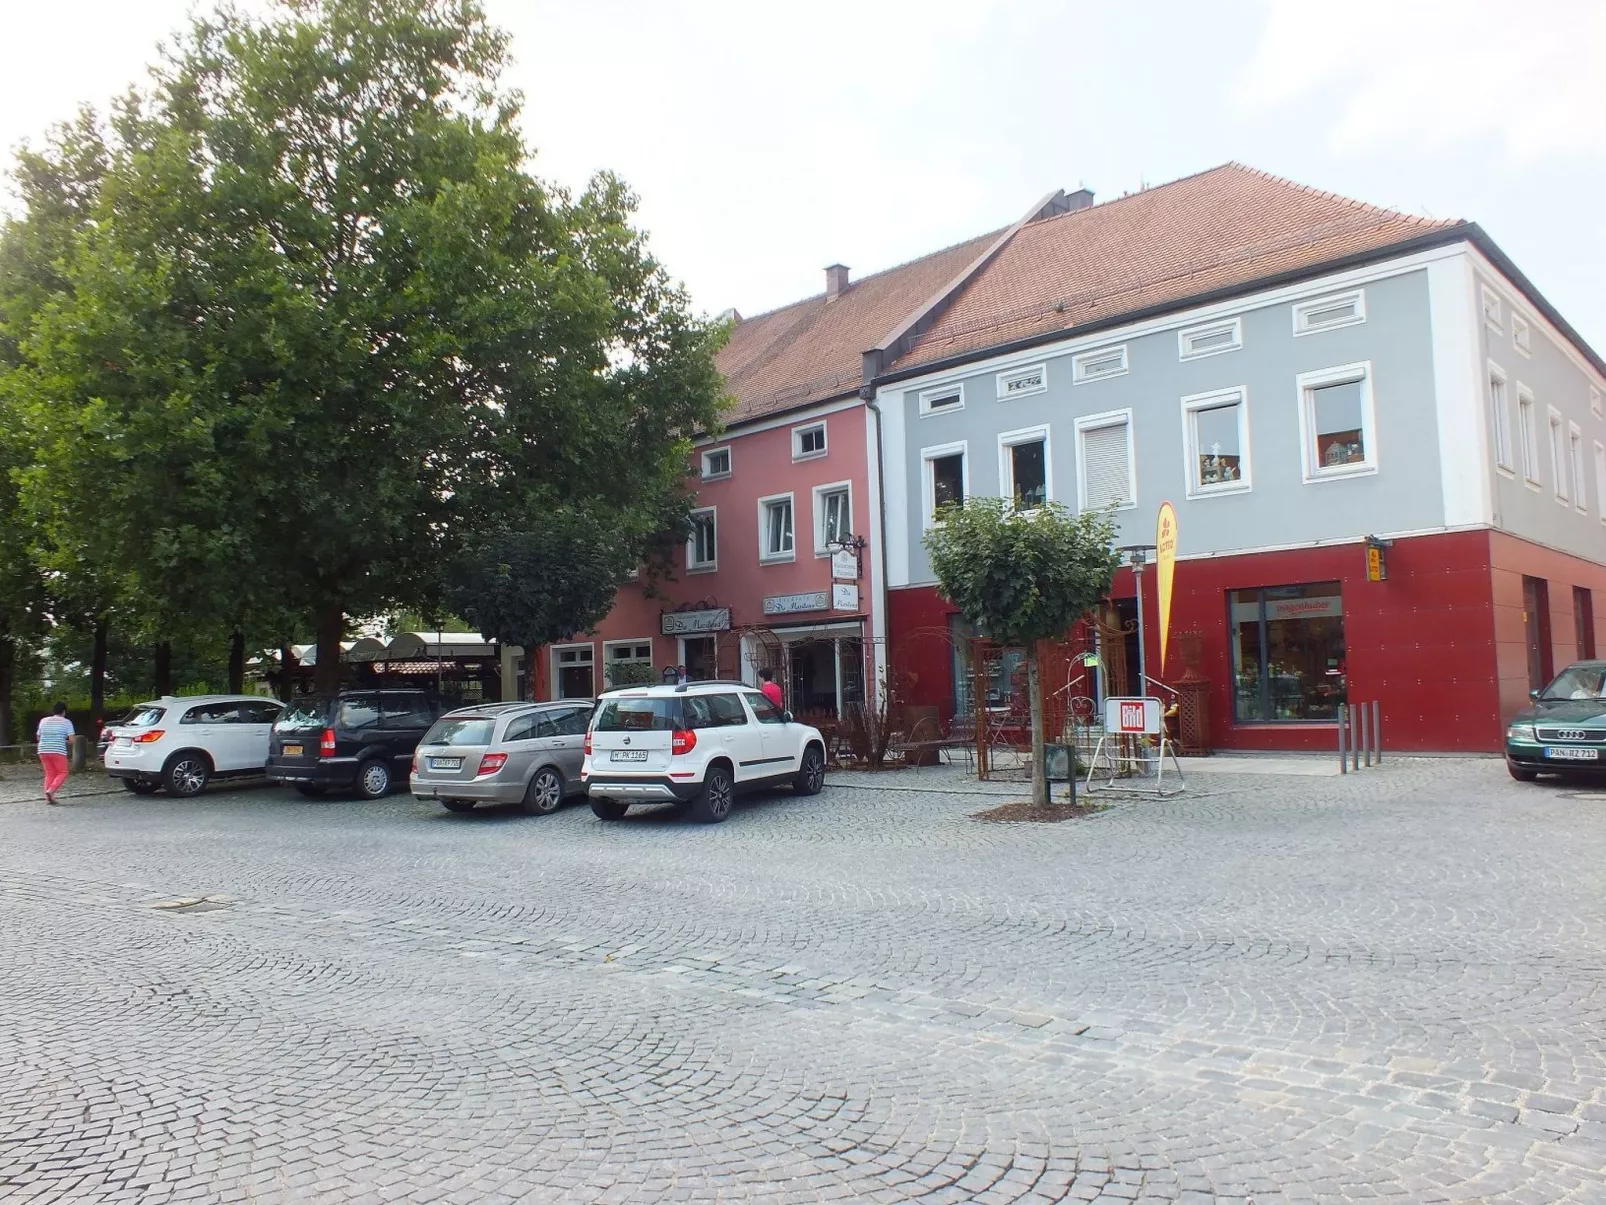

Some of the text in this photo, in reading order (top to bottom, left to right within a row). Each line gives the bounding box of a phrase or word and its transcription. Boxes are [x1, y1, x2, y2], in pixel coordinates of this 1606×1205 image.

[1122, 705, 1143, 728] Bild
[631, 751, 646, 759] 1165
[1550, 748, 1596, 757] PAN RZ 712
